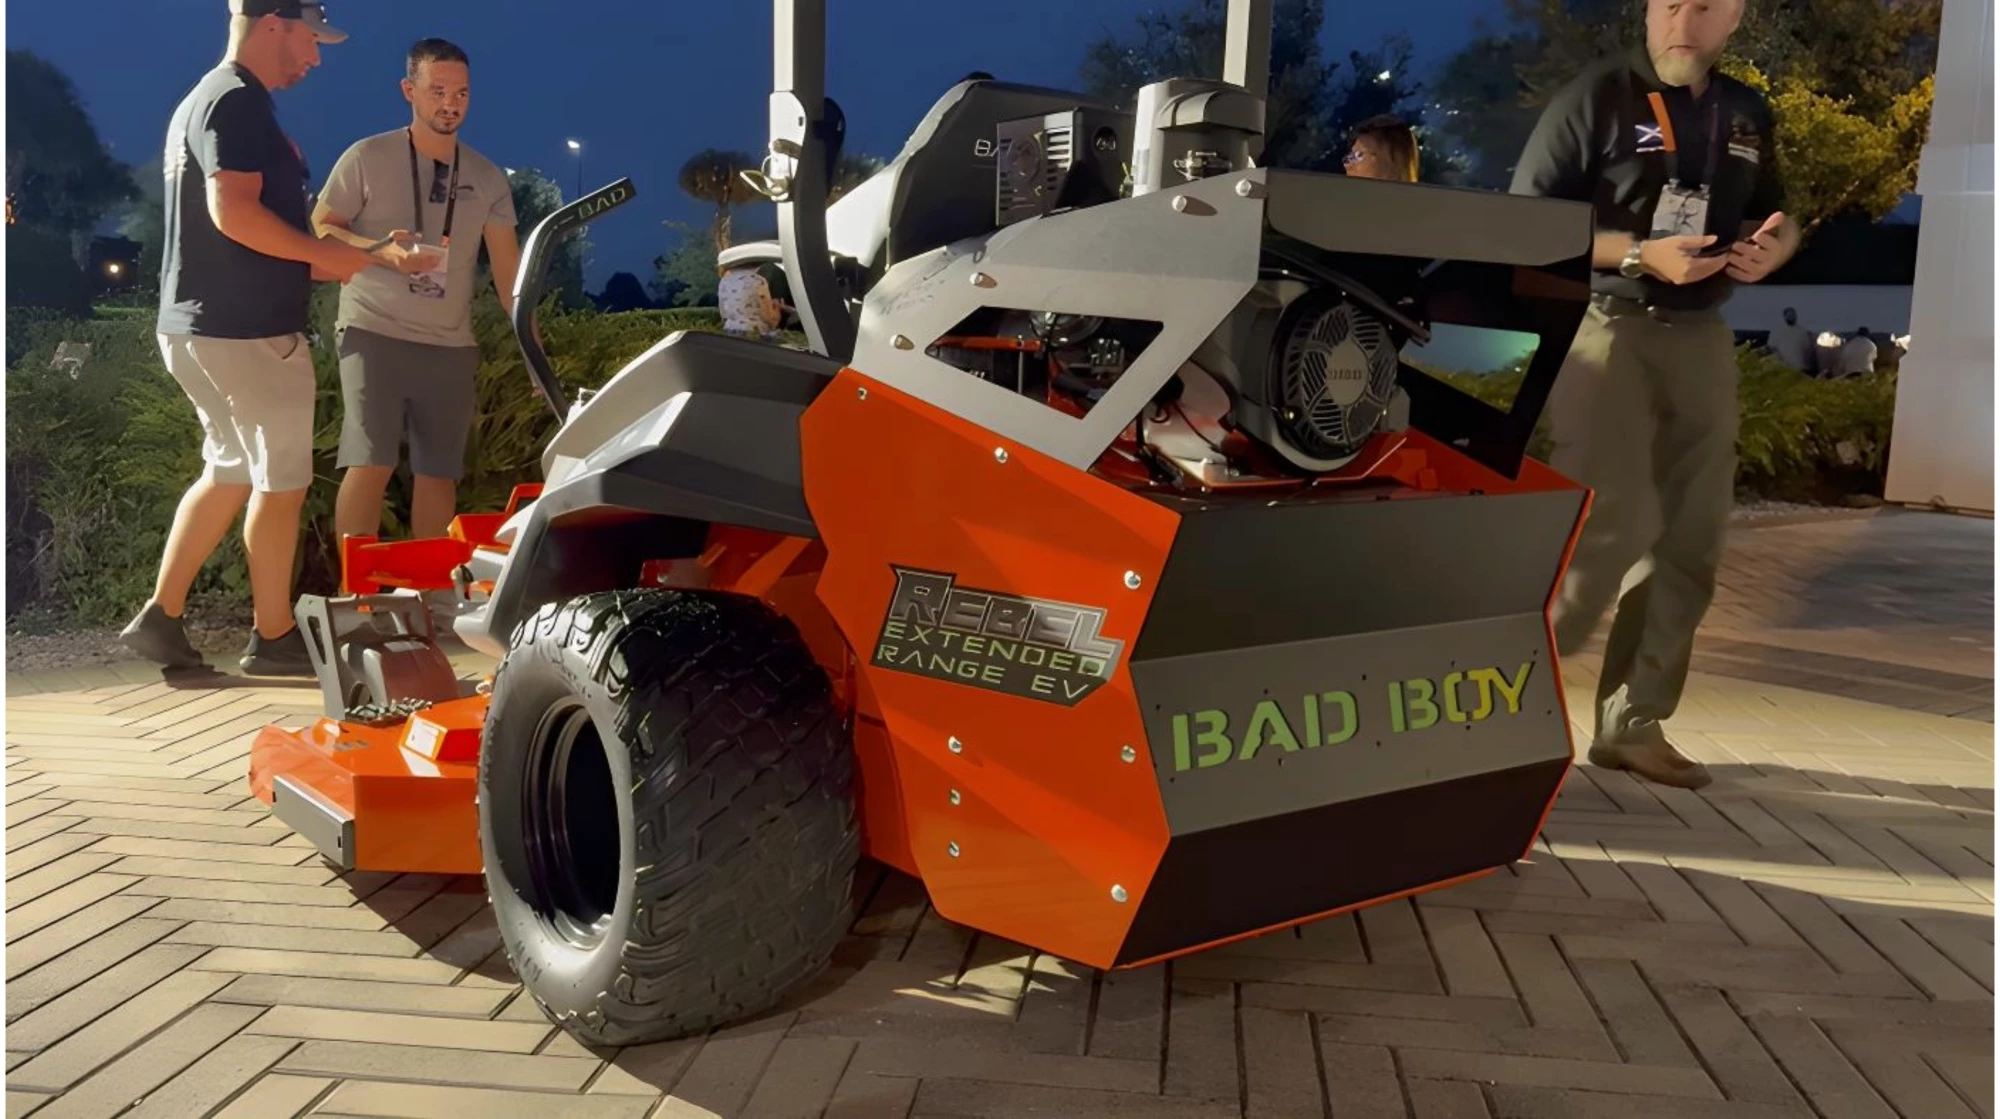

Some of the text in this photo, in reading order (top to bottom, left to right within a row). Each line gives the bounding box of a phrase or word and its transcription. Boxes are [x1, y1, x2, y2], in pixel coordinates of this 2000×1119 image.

[578, 187, 626, 219] BAD
[889, 567, 1118, 658] REBEL
[877, 645, 1089, 699] RANGE EV
[884, 621, 1107, 677] EXTENDED
[1172, 660, 1533, 772] BAD BOY
